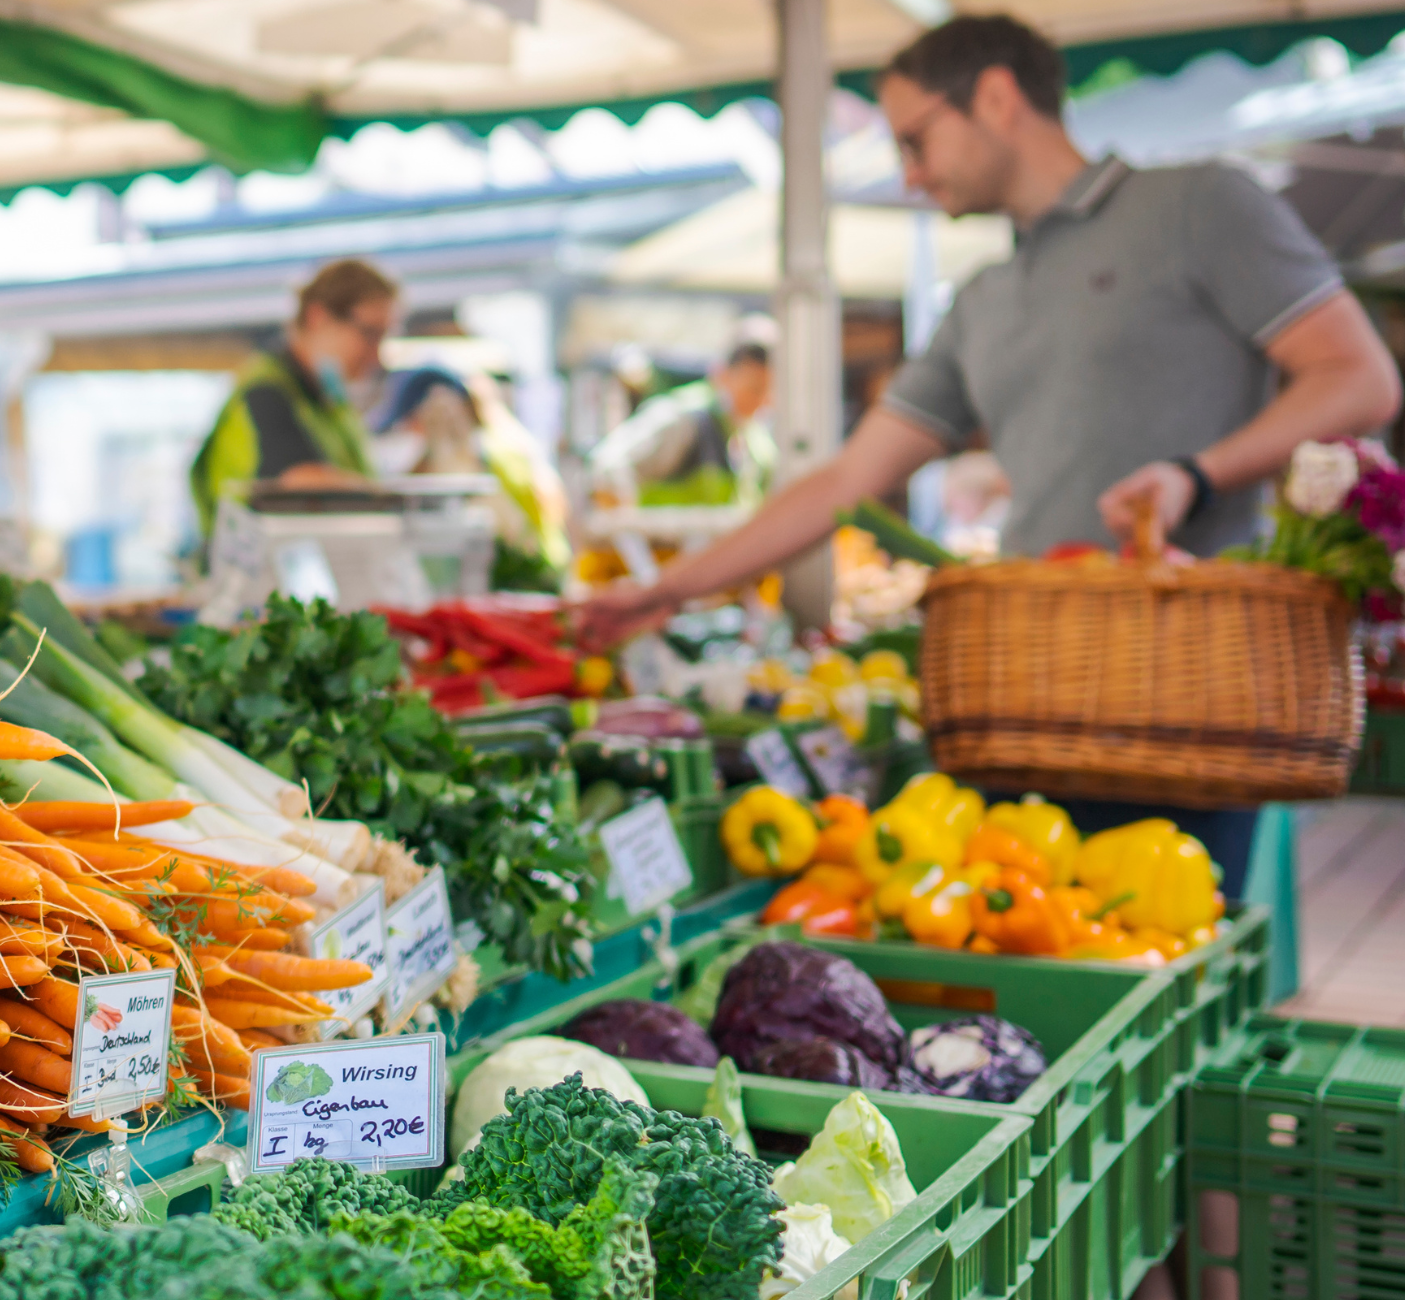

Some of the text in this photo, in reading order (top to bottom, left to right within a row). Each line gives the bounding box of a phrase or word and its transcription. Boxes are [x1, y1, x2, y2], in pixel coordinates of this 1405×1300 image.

[126, 996, 164, 1013] Möhren
[99, 1030, 152, 1053] Deutschland
[82, 1075, 93, 1094] I
[128, 1054, 161, 1086] 2,50€
[342, 1064, 417, 1083] Wirsing
[302, 1095, 388, 1120] Eigenbau
[263, 1115, 425, 1157] I kg 2,20€
